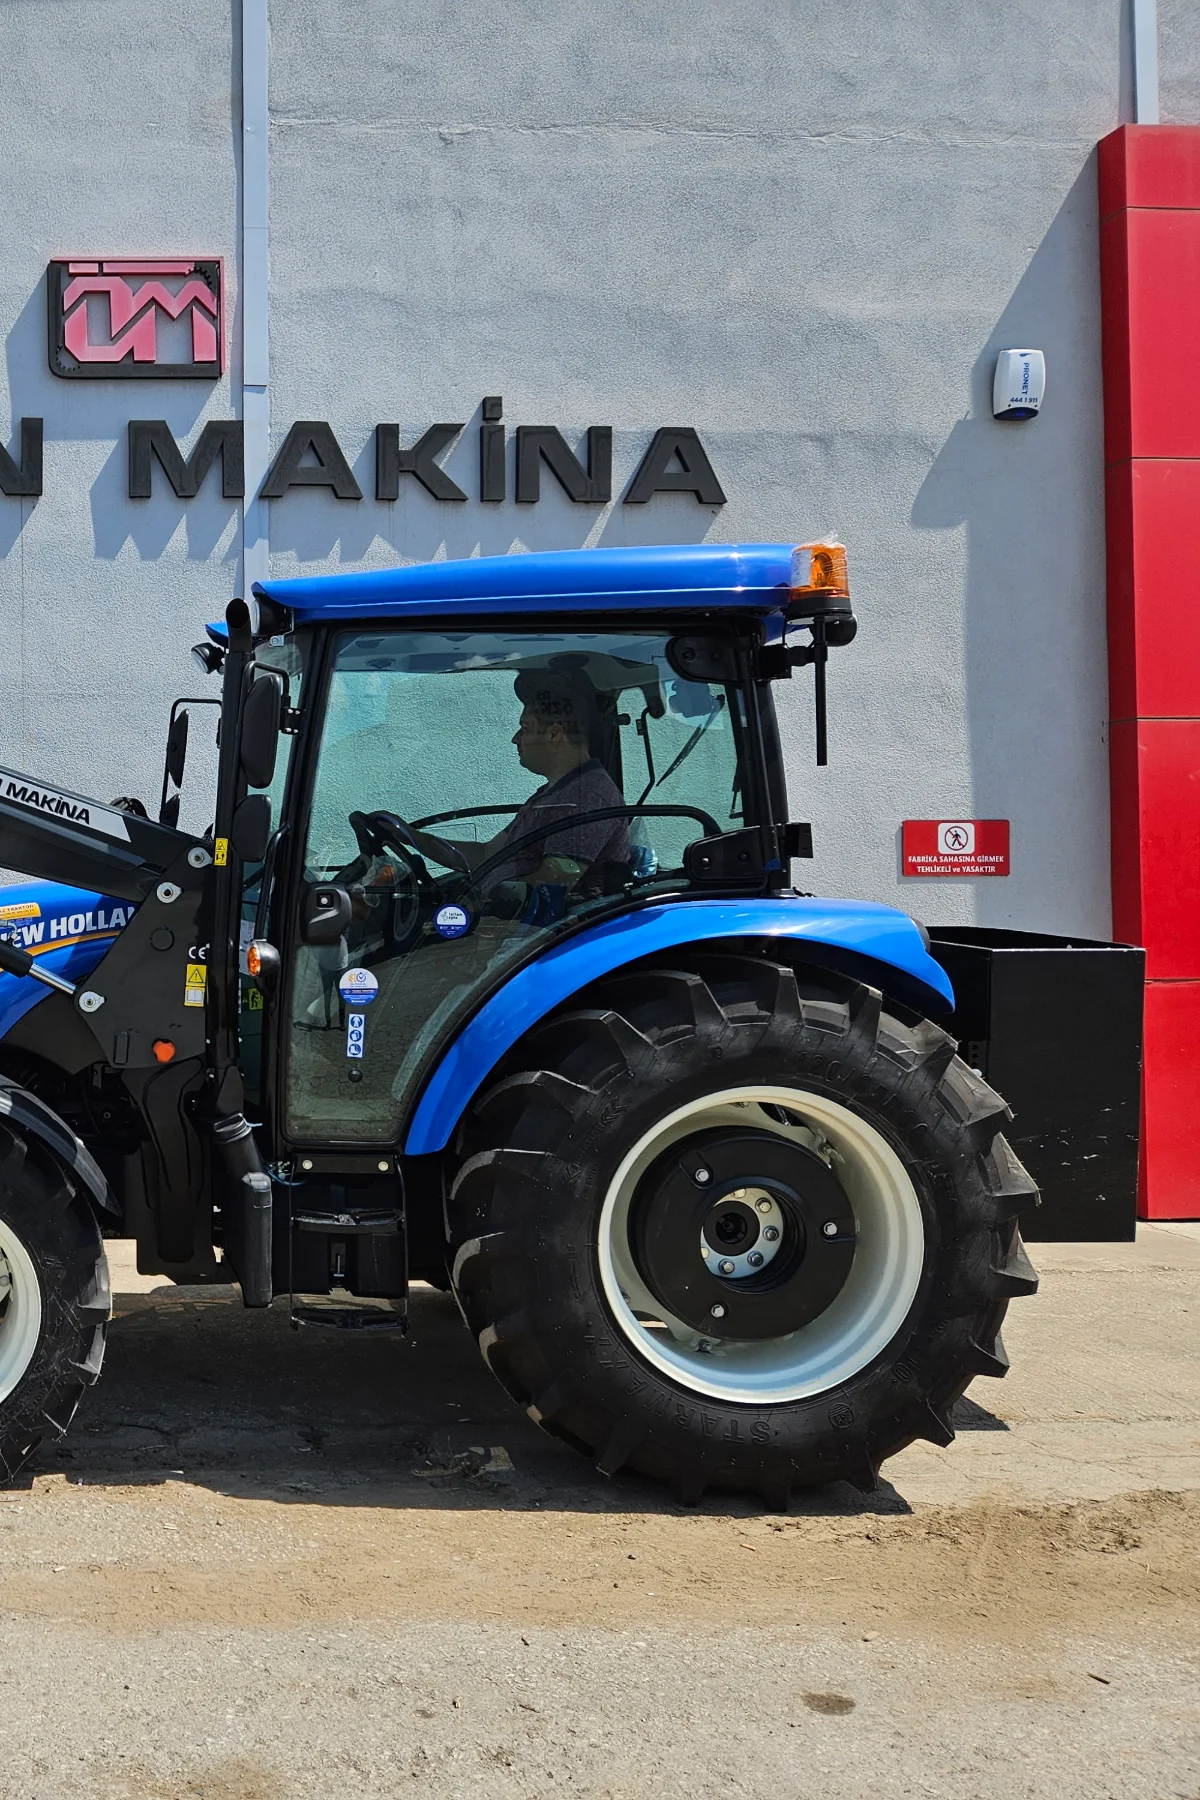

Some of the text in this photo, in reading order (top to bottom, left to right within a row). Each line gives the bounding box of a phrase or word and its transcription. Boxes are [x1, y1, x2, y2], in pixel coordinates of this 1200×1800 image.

[1021, 362, 1030, 395] PRONET
[128, 396, 728, 505] MAKİNA
[5, 782, 91, 825] MAKİNA
[908, 855, 938, 863] FABRİKA
[977, 855, 1004, 863] GİRMEK
[917, 865, 951, 873] TEHLİKELİ
[962, 865, 996, 873] YASAKTIR
